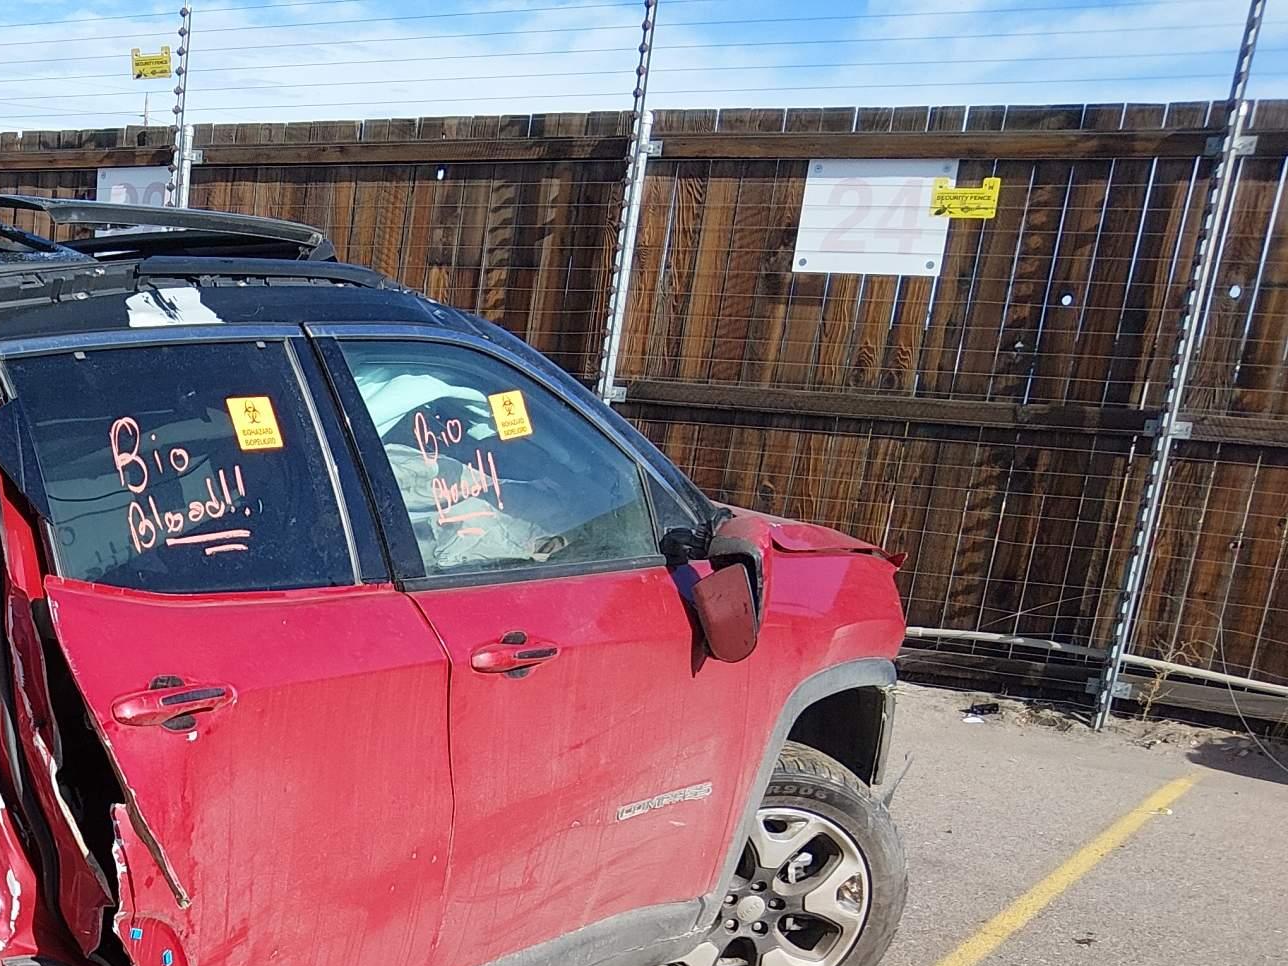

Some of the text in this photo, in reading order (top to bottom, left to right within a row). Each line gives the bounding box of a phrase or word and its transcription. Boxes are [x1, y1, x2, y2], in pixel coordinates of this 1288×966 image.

[819, 177, 924, 255] 24
[110, 416, 189, 494] Bio
[414, 412, 462, 465] Bio
